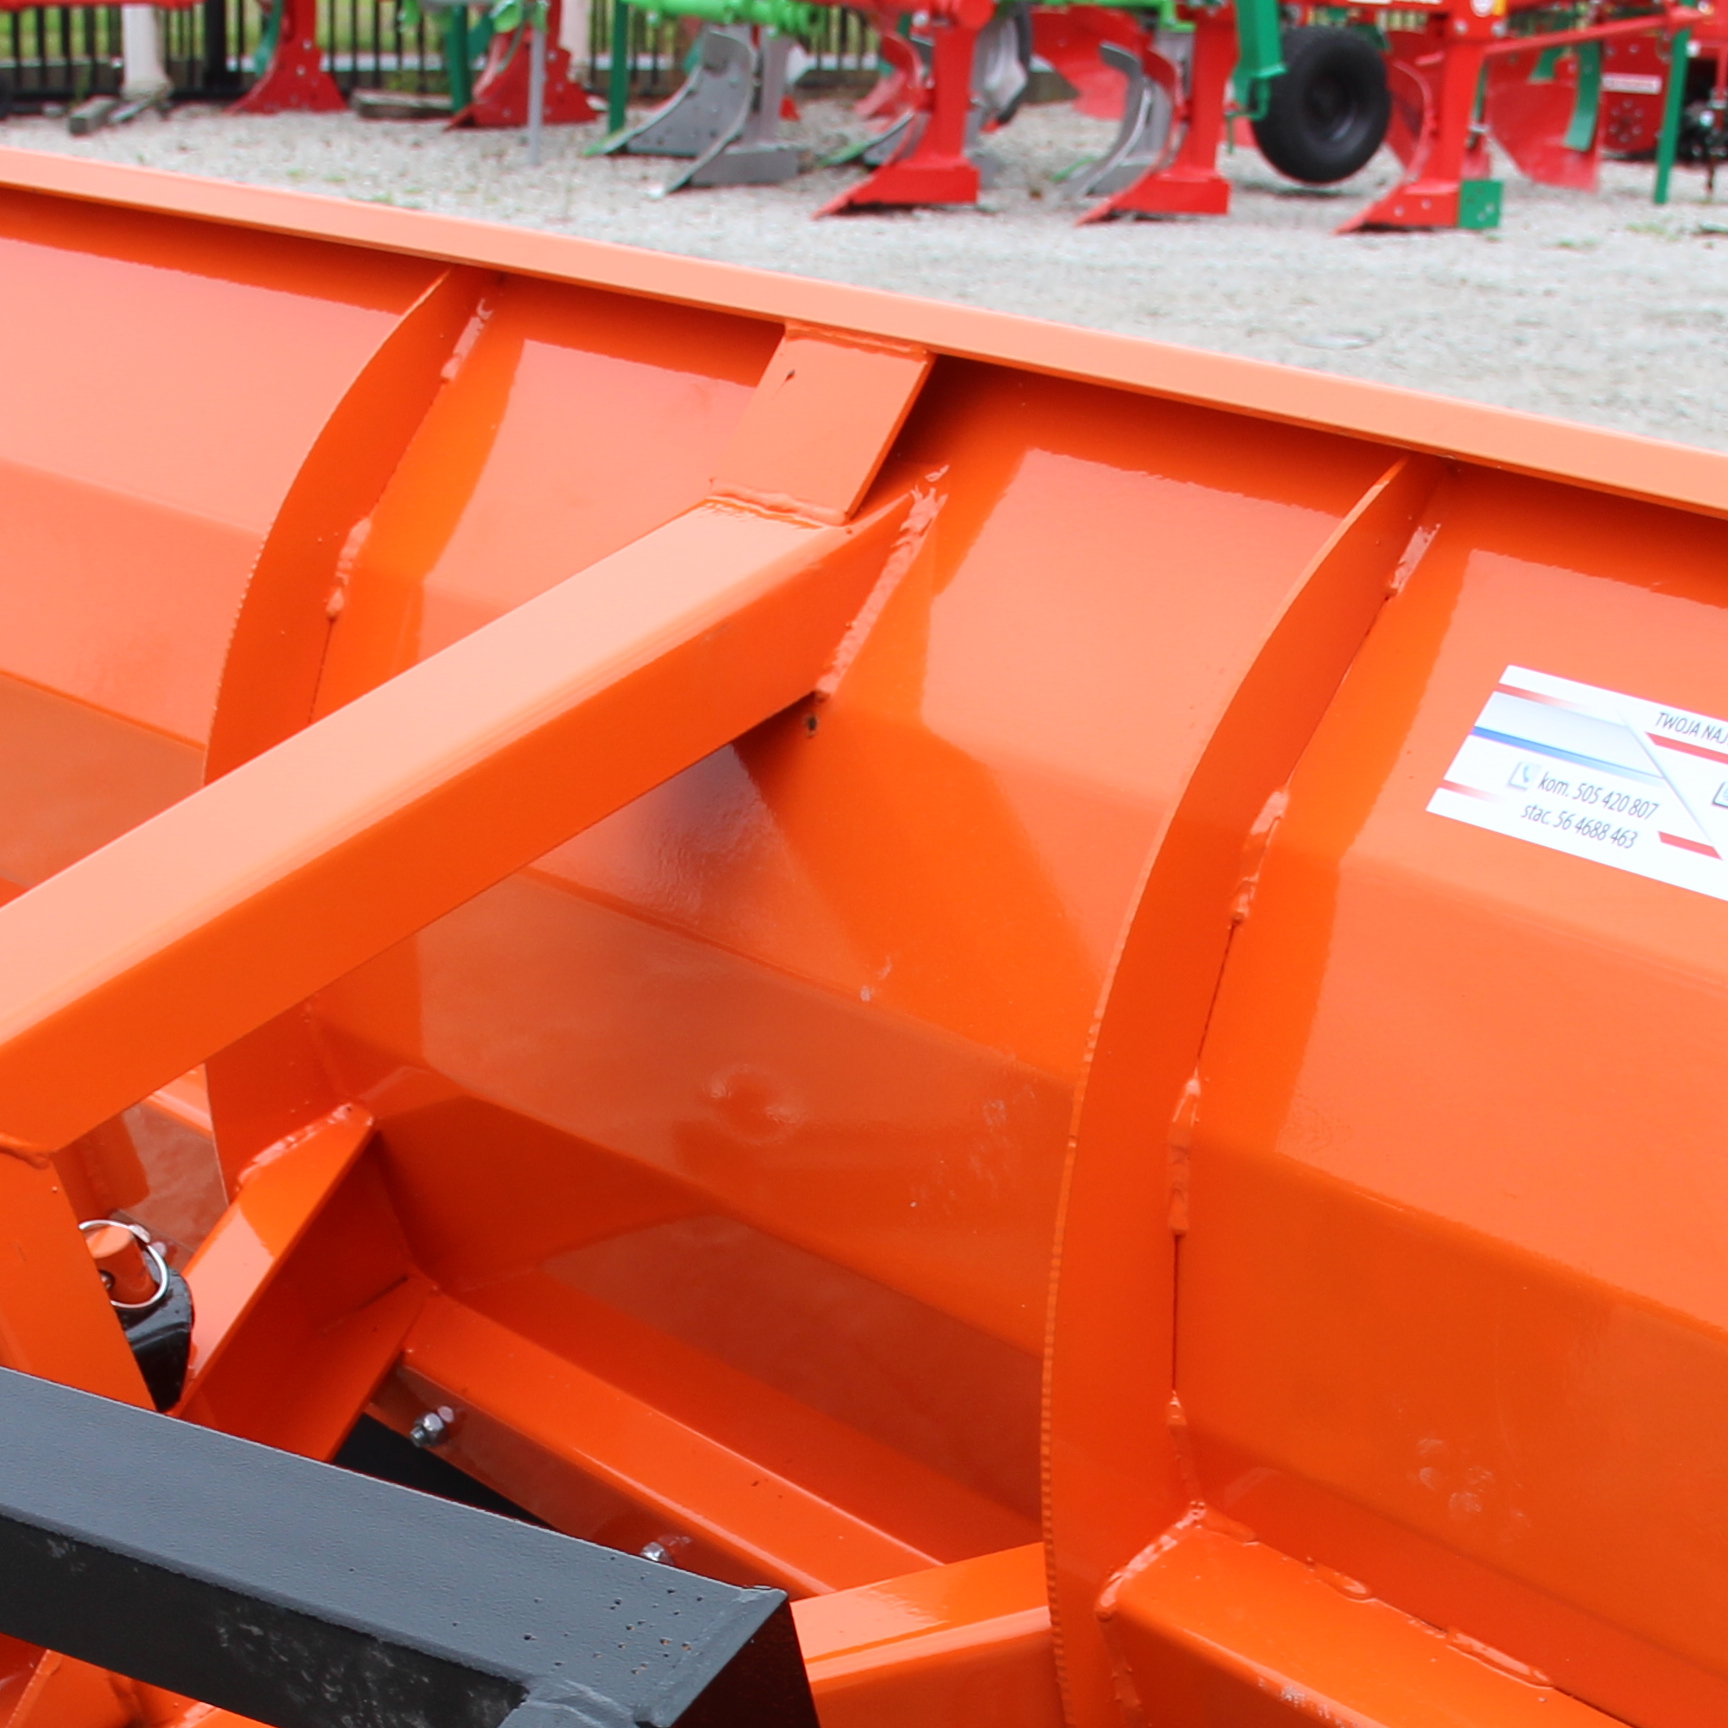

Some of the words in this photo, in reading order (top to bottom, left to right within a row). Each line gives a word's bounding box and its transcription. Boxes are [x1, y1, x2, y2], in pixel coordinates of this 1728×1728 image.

[1655, 711, 1702, 738] TWOJA
[1537, 771, 1569, 797] kom.
[1572, 782, 1603, 804] 505
[1601, 791, 1631, 813] 420
[1628, 798, 1660, 820] 807
[1553, 811, 1576, 830] 56
[1574, 816, 1611, 841] 4688
[1610, 827, 1639, 849] 463
